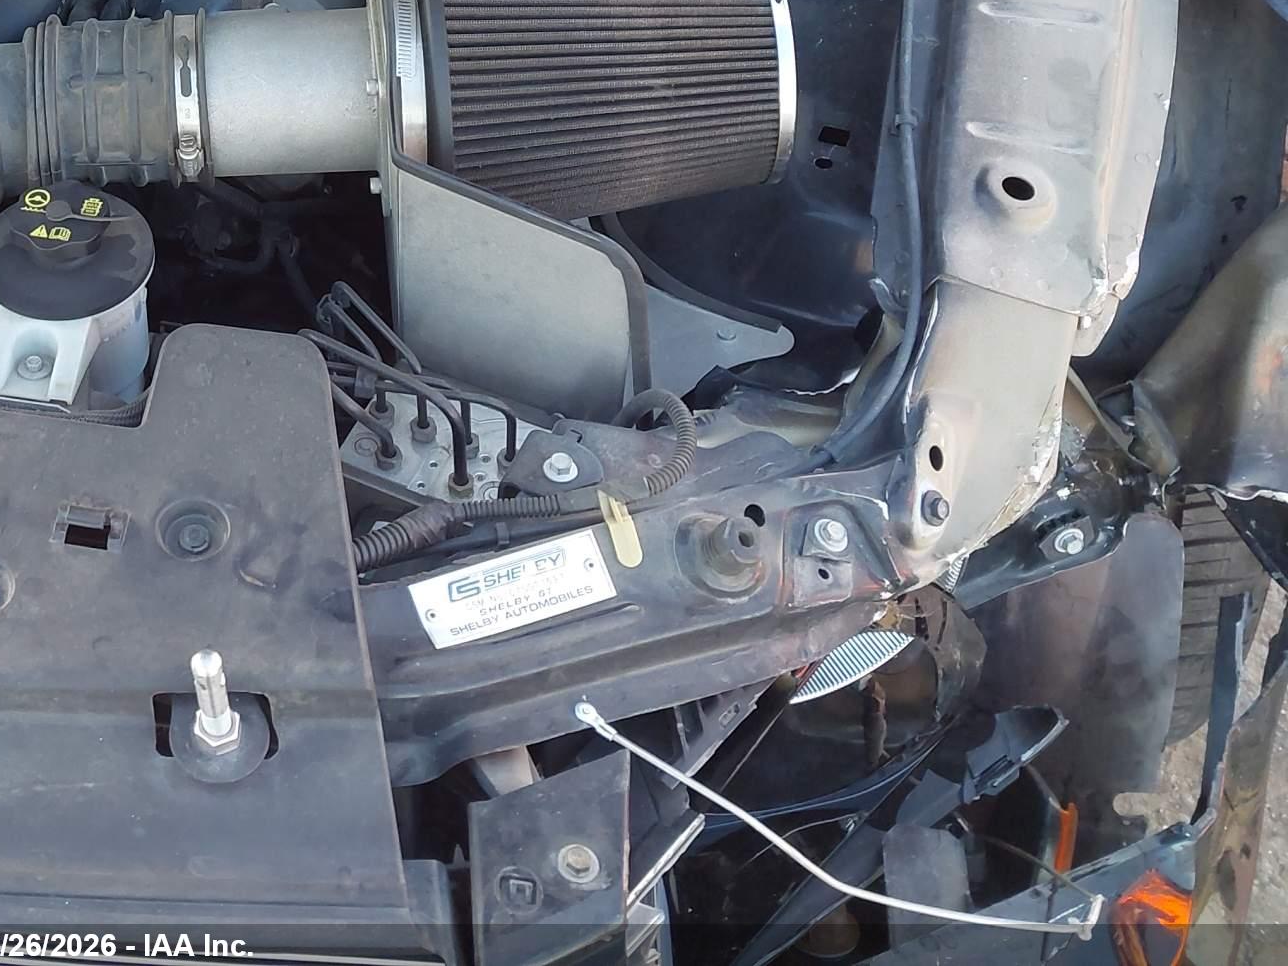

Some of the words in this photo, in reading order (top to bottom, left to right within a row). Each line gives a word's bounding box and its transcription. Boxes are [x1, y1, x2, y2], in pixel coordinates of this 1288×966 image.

[450, 615, 499, 636] SHELBY
[505, 585, 593, 619] AUTOMOBILES
[479, 595, 531, 616] SHELBY
